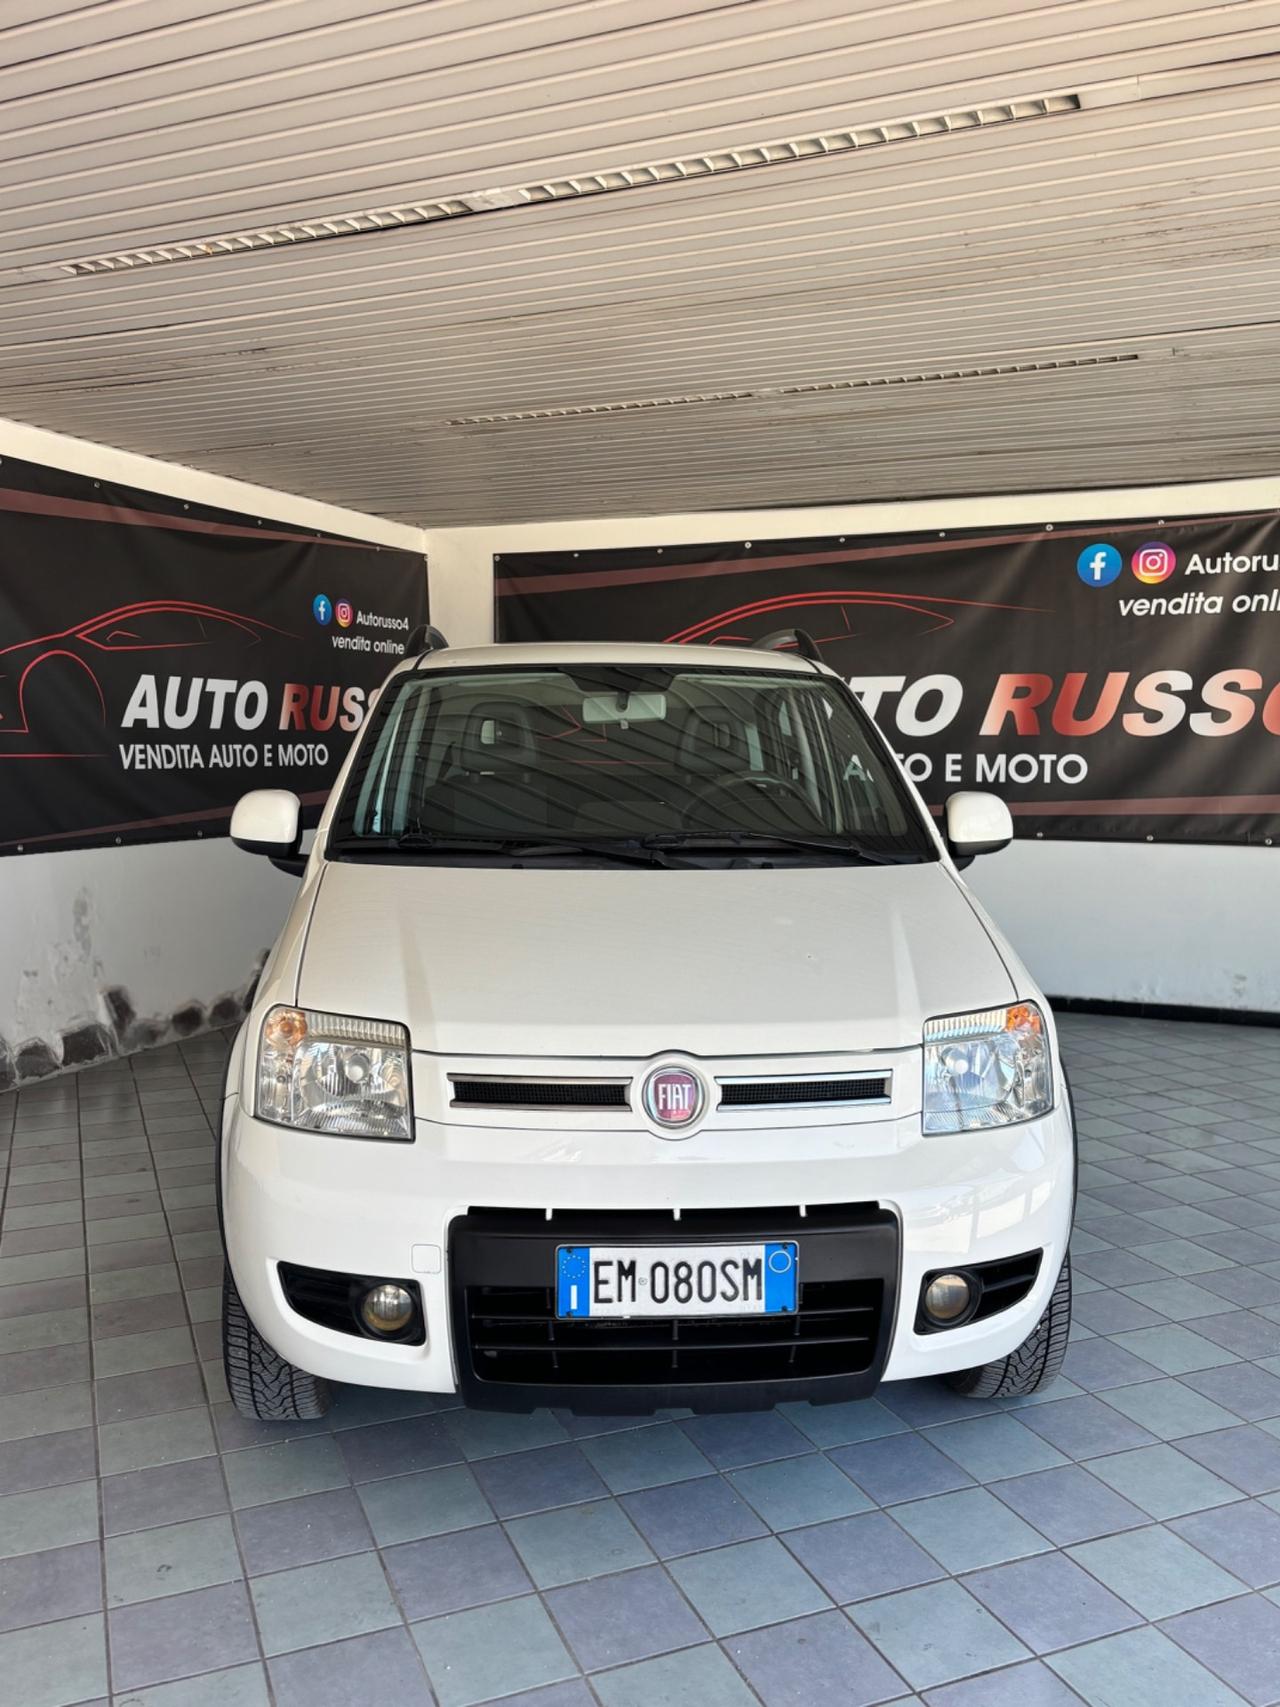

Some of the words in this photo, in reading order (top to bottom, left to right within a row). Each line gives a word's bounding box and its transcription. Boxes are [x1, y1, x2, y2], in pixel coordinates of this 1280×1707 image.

[1119, 592, 1223, 616] vendita
[356, 610, 410, 631] Autorusso4
[332, 635, 371, 652] vendita
[373, 639, 405, 655] online
[121, 674, 268, 731] AUTO
[279, 682, 378, 732] RUS
[843, 674, 963, 737] TO
[979, 668, 1280, 737] RUSS
[119, 744, 204, 770] VENDITA
[209, 744, 258, 768] AUTO
[264, 745, 273, 767] E
[278, 743, 329, 768] MOTO
[945, 754, 962, 782] E
[976, 754, 1088, 784] MOTO
[658, 1083, 692, 1111] FIAT
[593, 1260, 637, 1304] EM
[650, 1258, 762, 1304] 080SM
